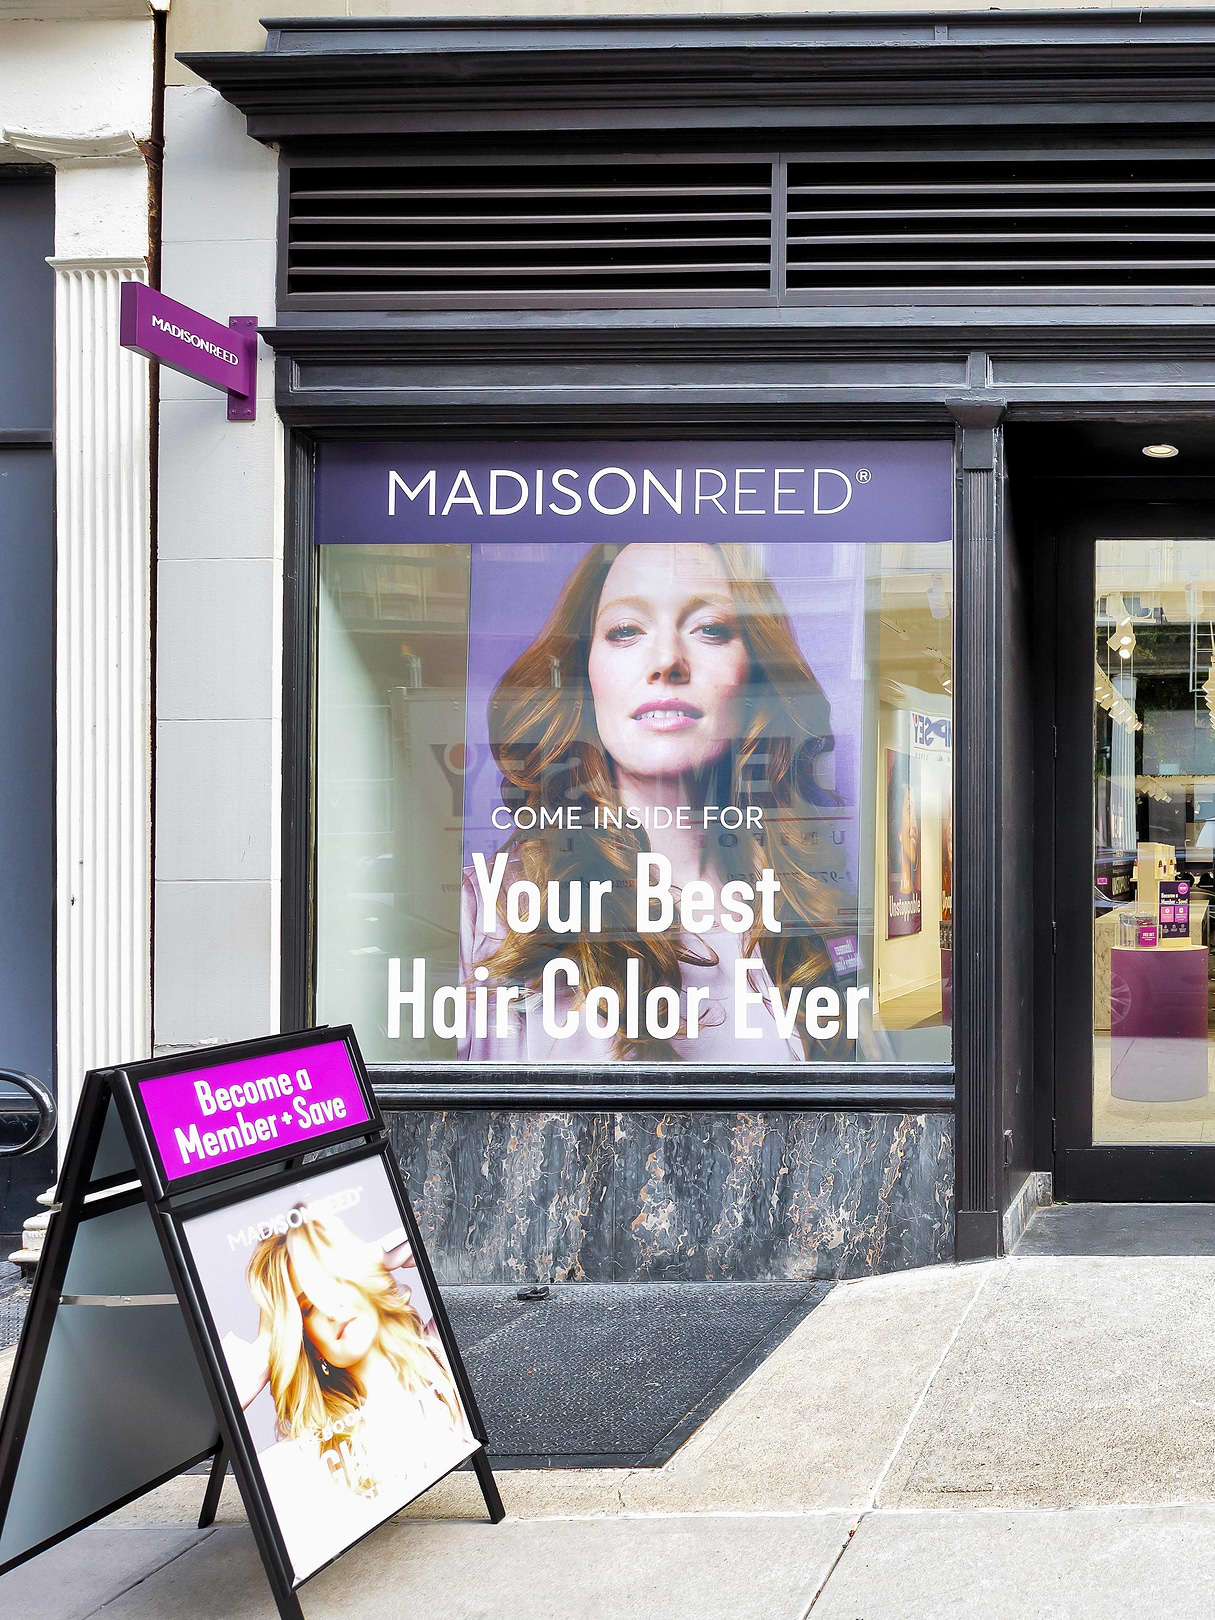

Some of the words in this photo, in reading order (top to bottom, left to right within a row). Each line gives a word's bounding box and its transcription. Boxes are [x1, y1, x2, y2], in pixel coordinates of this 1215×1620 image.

[151, 314, 239, 365] MADISONREED
[491, 805, 581, 830] COME
[593, 806, 692, 830] INSIDE
[703, 806, 764, 830] FOR
[472, 852, 613, 934] Your
[637, 852, 783, 934] Best
[888, 892, 921, 922] Unstoppable
[387, 957, 520, 1039] Hair
[542, 957, 709, 1039] Color
[734, 957, 870, 1039] Ever
[193, 1071, 294, 1117] Become
[295, 1068, 313, 1092] a
[173, 1111, 279, 1165] Member
[281, 1111, 293, 1126] +
[292, 1095, 348, 1129] Save
